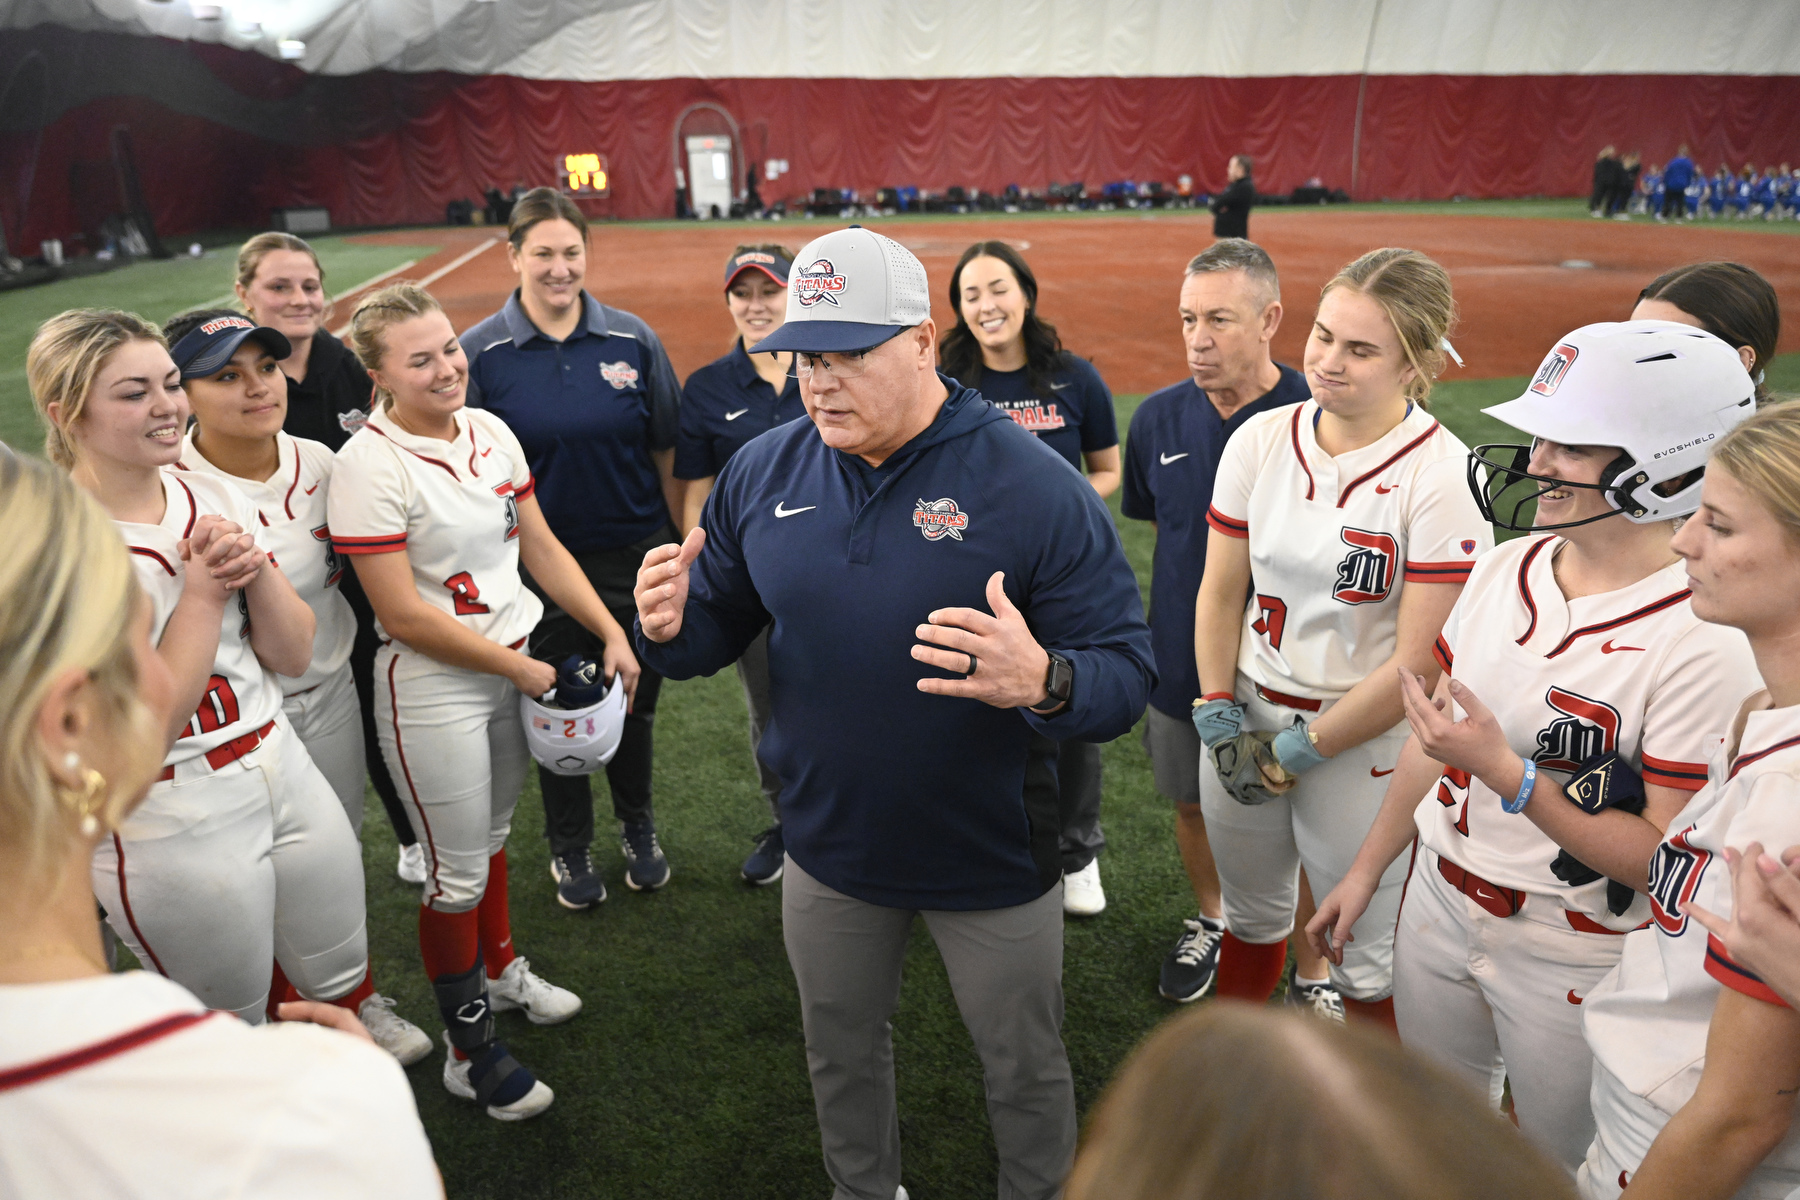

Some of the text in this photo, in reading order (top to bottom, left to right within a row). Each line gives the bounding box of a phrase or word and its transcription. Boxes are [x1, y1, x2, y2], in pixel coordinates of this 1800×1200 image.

[795, 276, 844, 292] TITANS
[200, 318, 255, 335] TITANS
[1004, 404, 1065, 431] BALL
[1653, 433, 1715, 459] EVOSHIELD
[914, 510, 966, 527] TITANS
[443, 570, 490, 616] 2
[563, 719, 576, 738] 2
